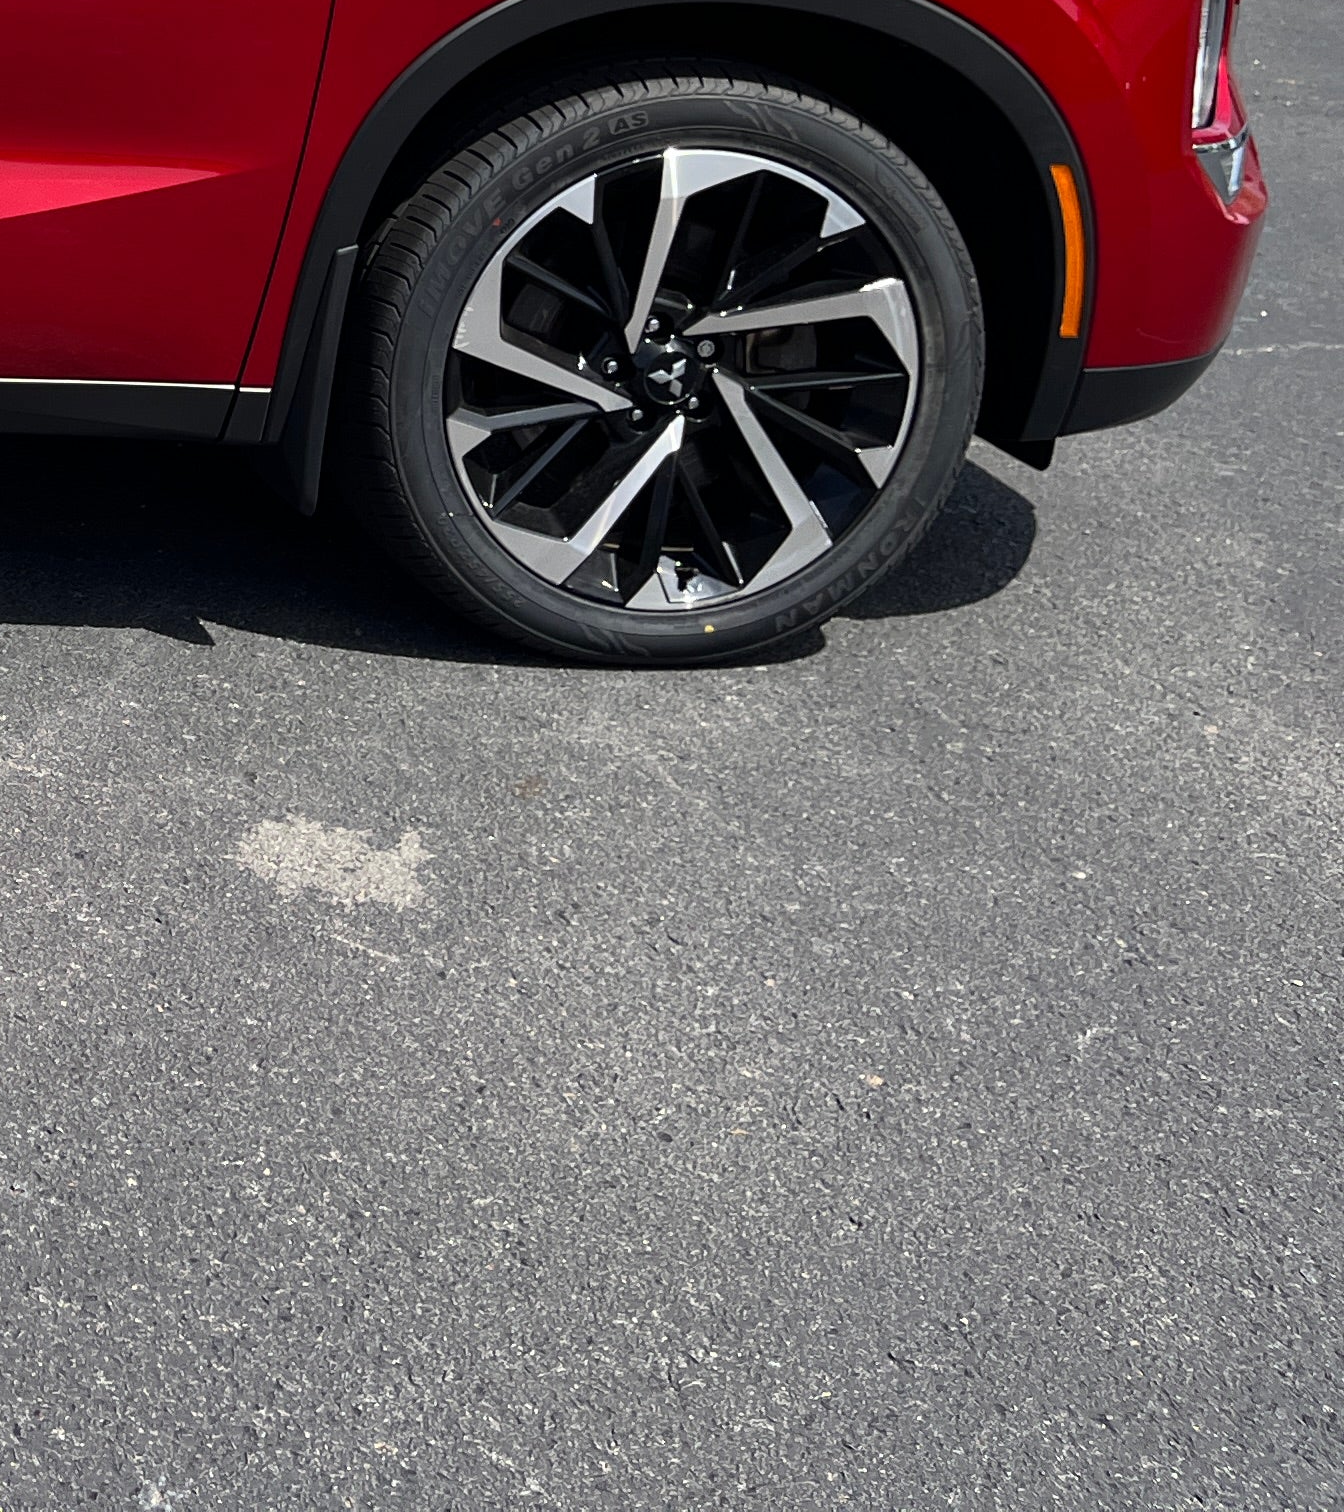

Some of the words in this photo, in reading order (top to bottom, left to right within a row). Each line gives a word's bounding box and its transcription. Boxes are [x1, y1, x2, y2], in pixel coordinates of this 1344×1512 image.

[511, 143, 575, 191] Gen
[583, 125, 602, 148] 2
[612, 111, 649, 135] AS
[774, 495, 928, 634] IRONMAN
